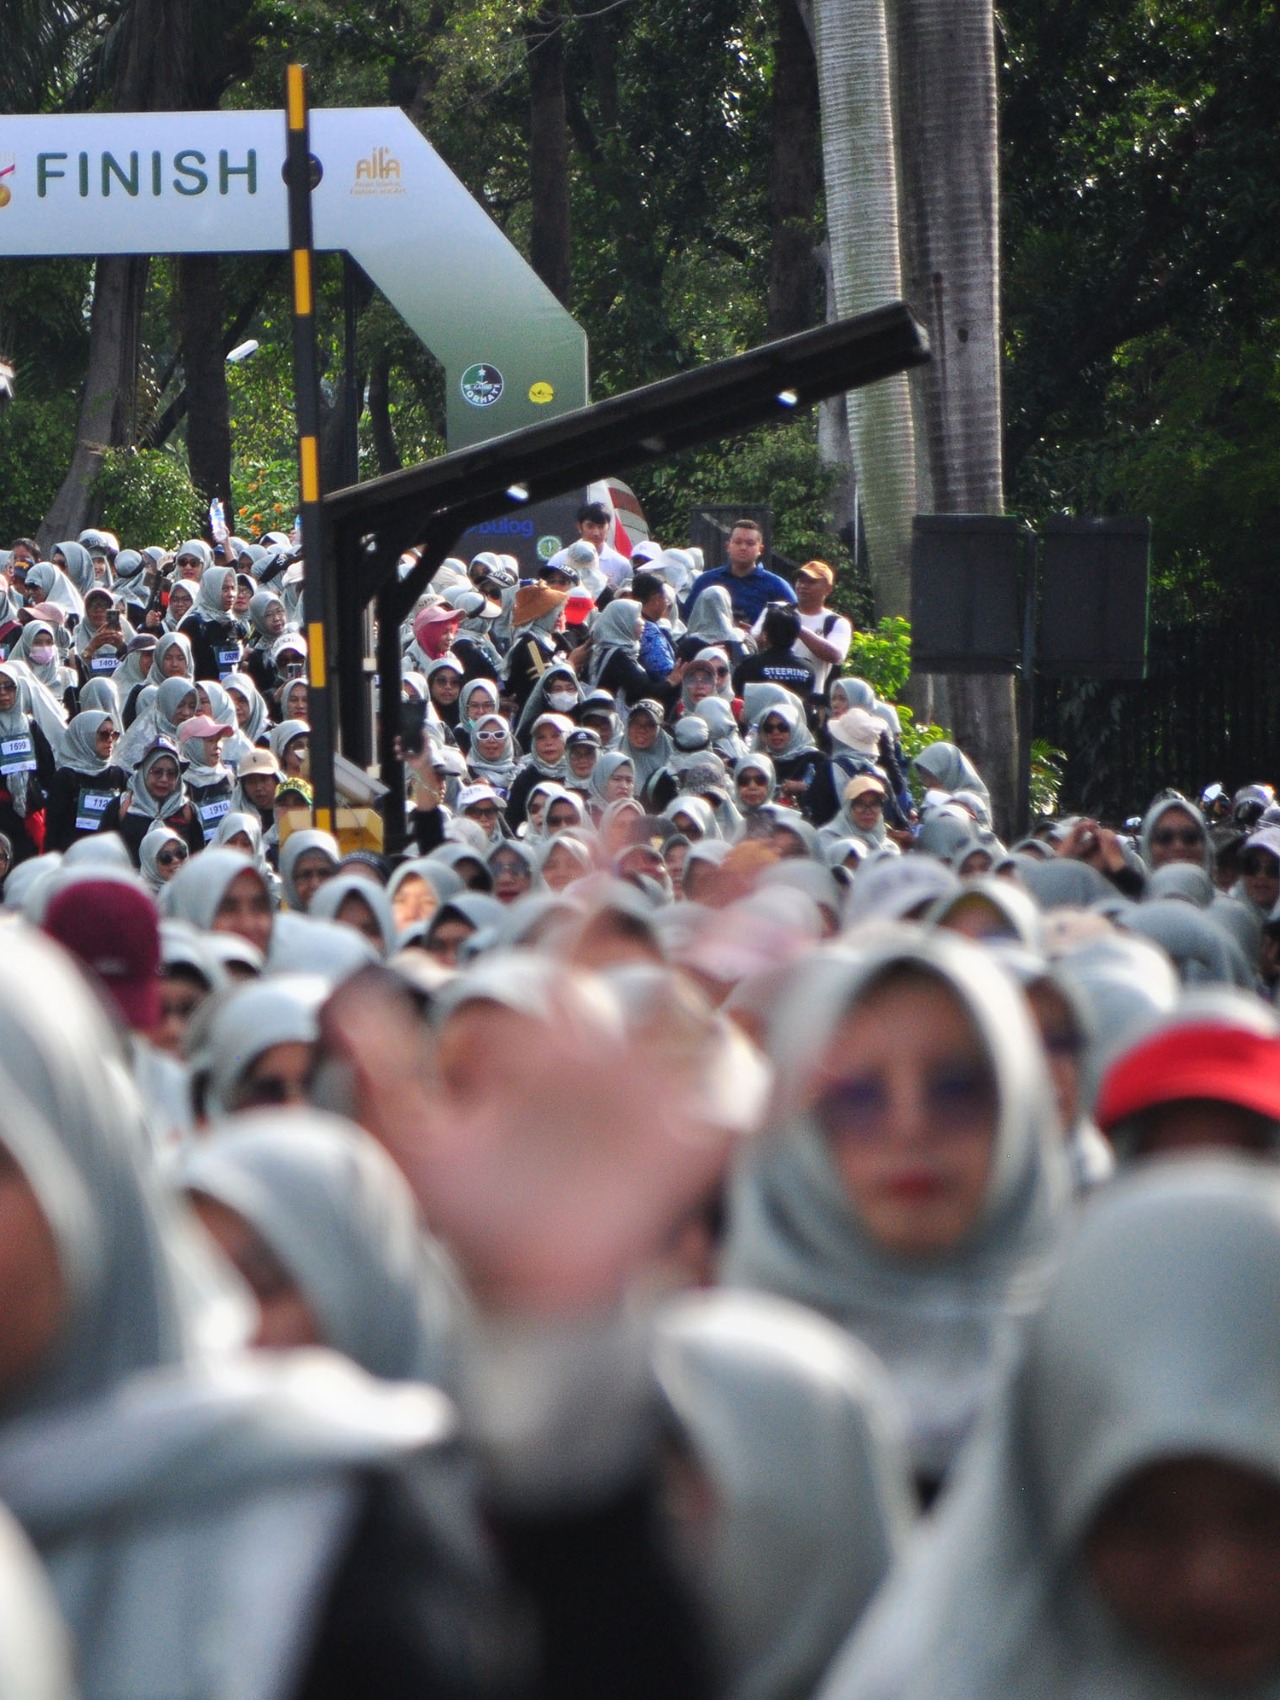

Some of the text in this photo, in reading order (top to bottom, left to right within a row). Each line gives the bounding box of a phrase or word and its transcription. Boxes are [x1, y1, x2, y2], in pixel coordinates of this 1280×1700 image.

[36, 149, 257, 198] FINISH
[763, 667, 810, 678] STEERING
[93, 798, 109, 808] 112
[209, 802, 229, 816] 1910
